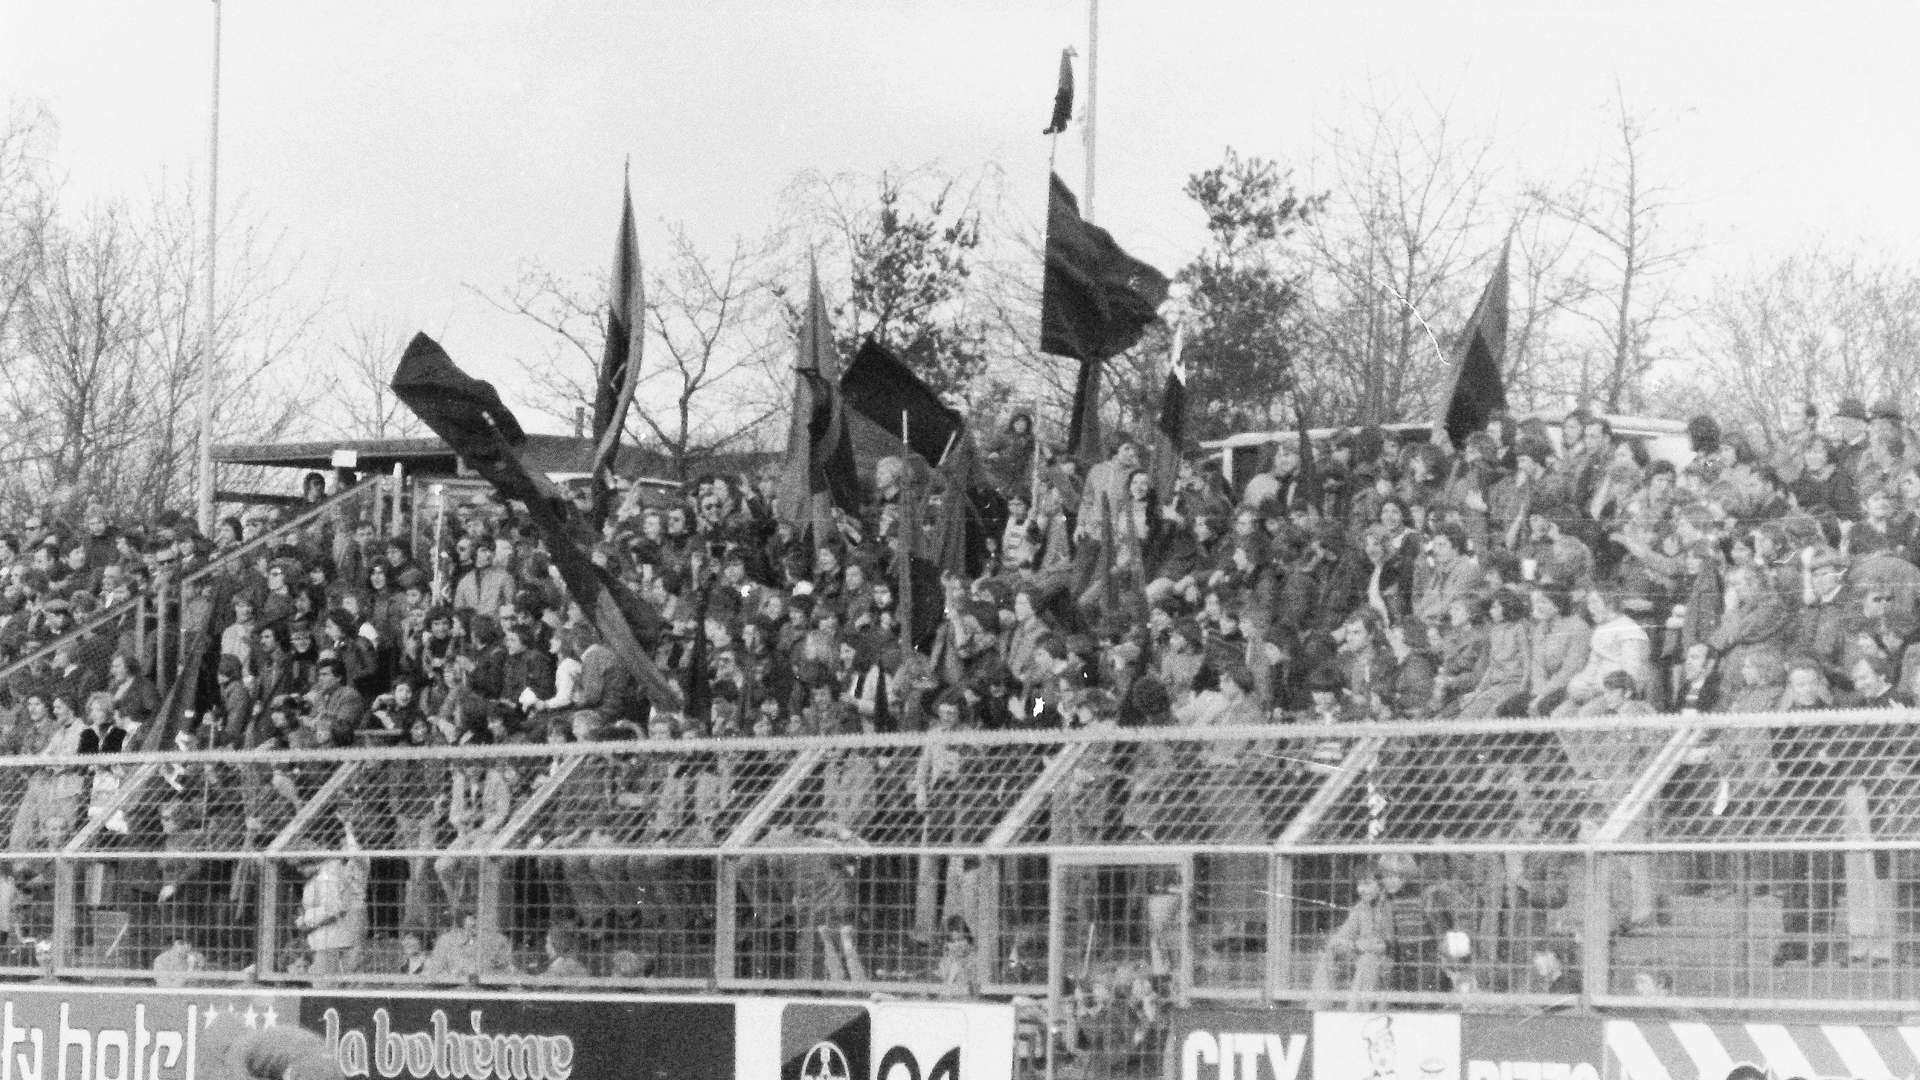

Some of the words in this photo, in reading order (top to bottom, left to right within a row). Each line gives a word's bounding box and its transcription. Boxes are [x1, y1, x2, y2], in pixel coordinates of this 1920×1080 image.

[58, 1002, 197, 1080] hotel
[322, 1008, 369, 1077] la
[1182, 1029, 1308, 1080] CITY
